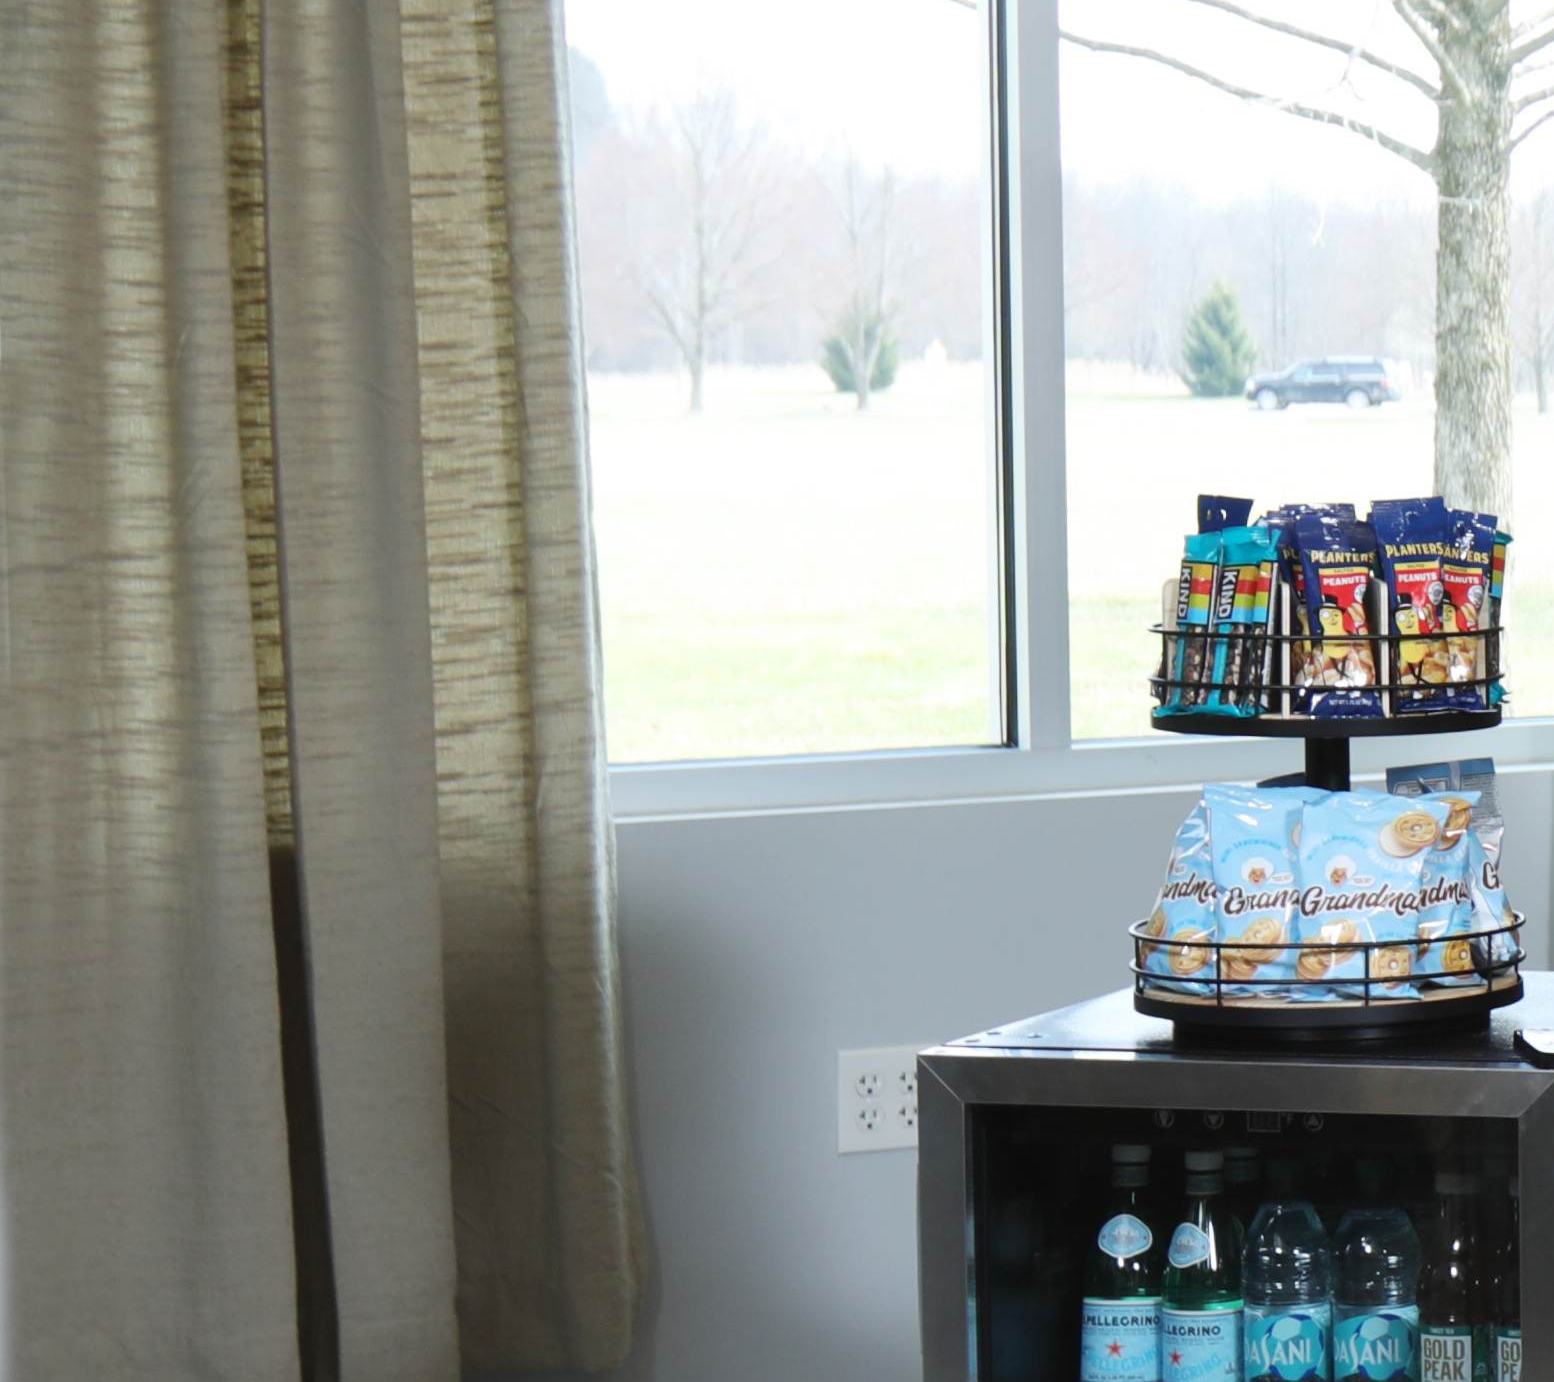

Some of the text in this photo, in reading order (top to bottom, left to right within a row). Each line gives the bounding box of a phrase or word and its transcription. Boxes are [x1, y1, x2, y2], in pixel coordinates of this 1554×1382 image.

[1310, 549, 1376, 564] PLANTERS
[1385, 542, 1445, 559] PLANTERS
[1322, 575, 1367, 586] PEANUTS
[1397, 572, 1438, 583] PEANUTS
[1177, 566, 1193, 618] KIND
[1218, 569, 1238, 618] KIND
[1423, 1338, 1465, 1360] GOLD
[1424, 1359, 1465, 1381] PEAK
